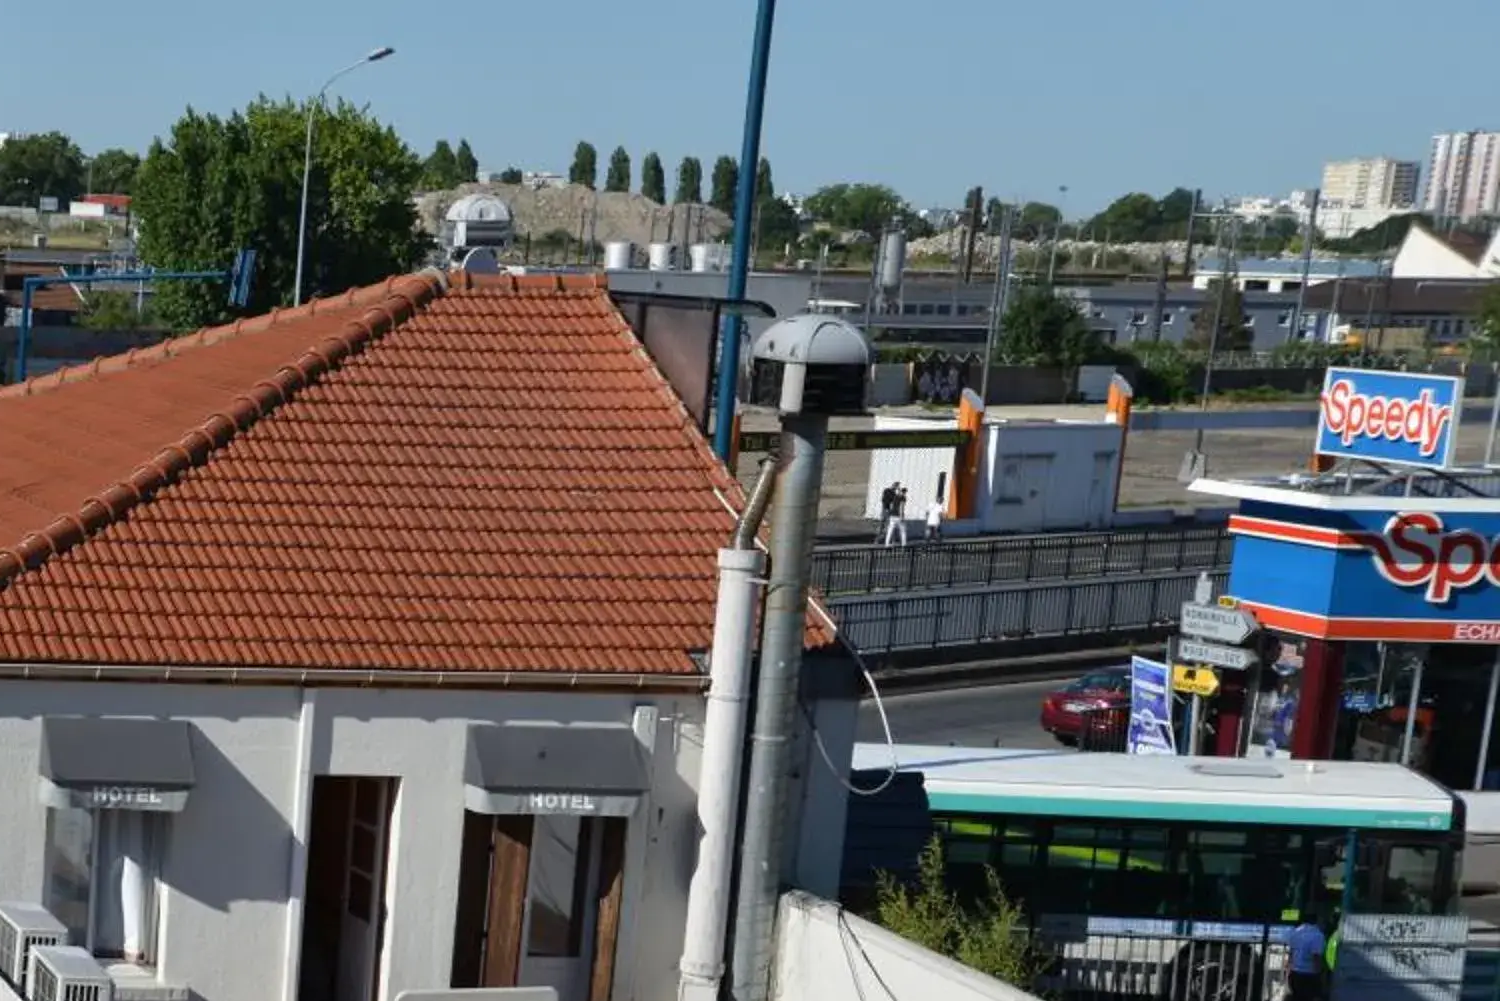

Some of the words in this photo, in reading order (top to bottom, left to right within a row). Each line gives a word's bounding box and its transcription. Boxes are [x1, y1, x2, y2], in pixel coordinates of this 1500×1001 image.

[1321, 380, 1451, 456] Speedy
[1367, 511, 1500, 603] Sp
[93, 785, 162, 804] HOTEL
[529, 791, 595, 810] HOTEL
